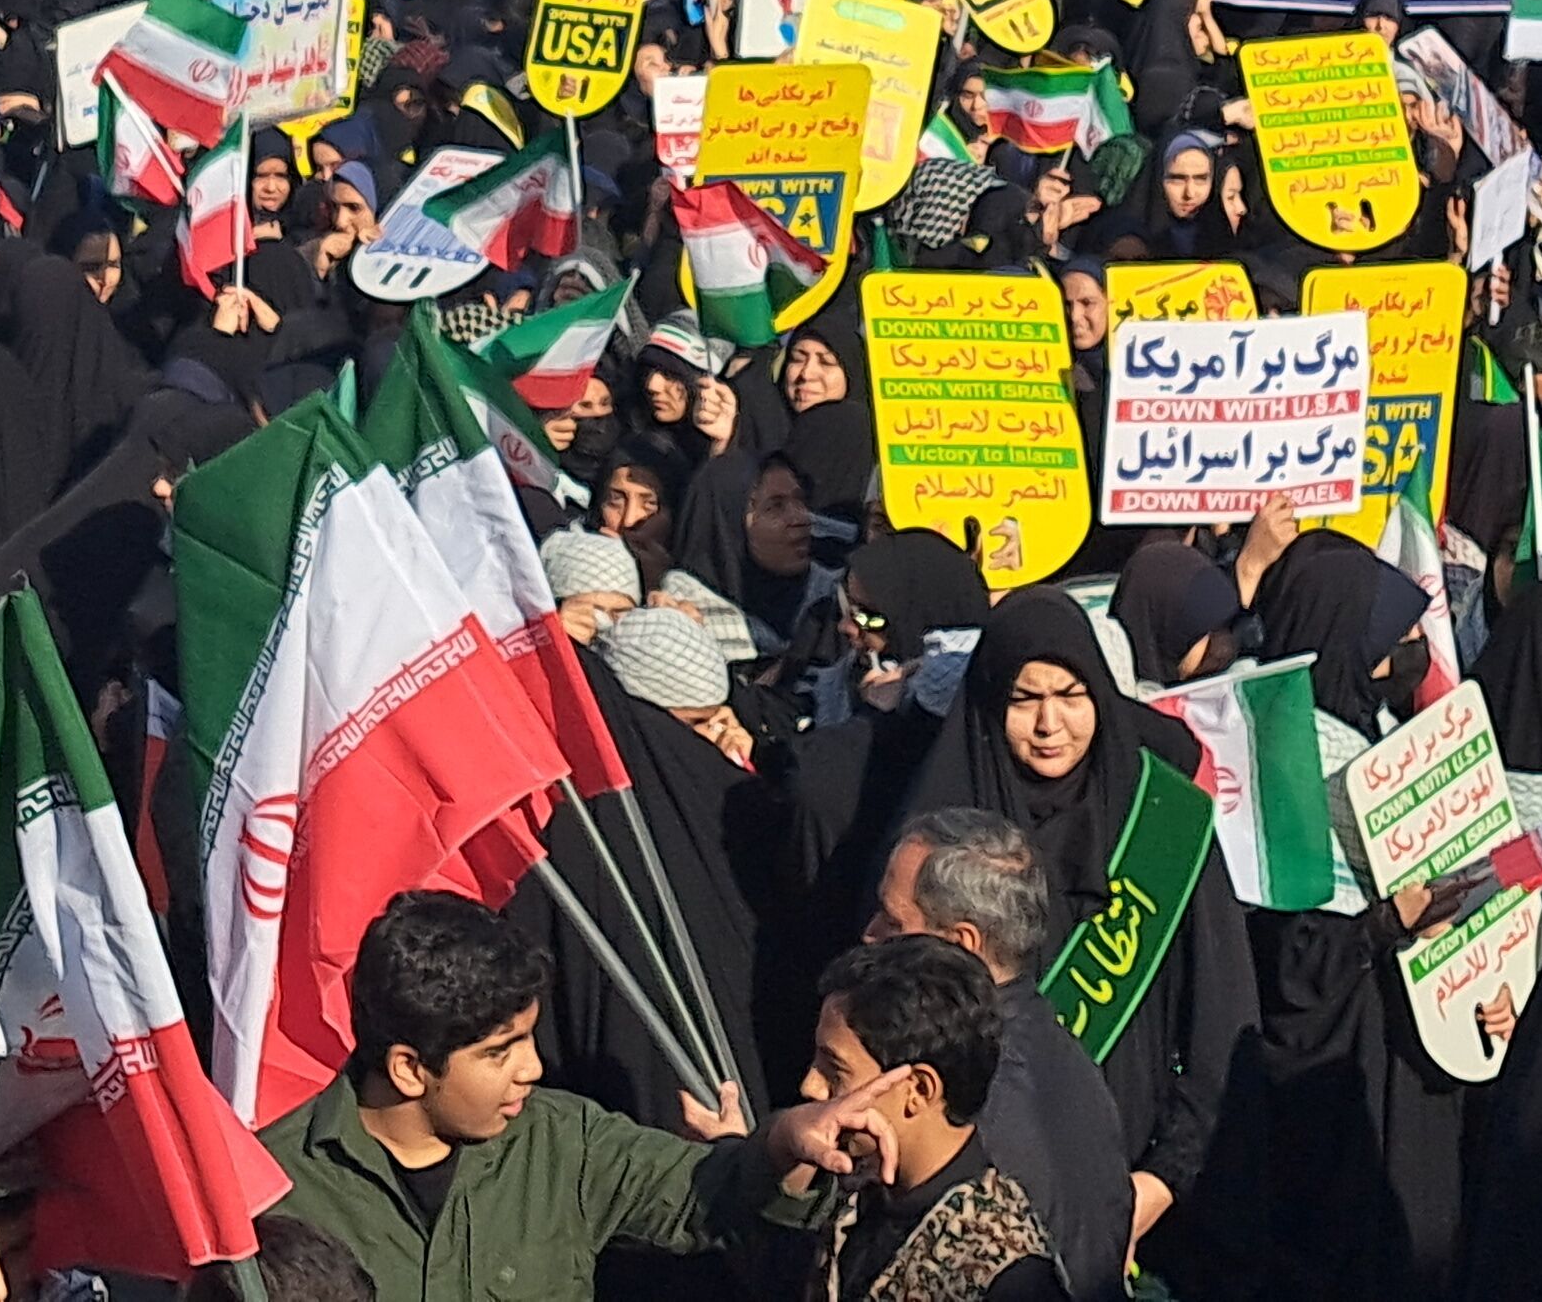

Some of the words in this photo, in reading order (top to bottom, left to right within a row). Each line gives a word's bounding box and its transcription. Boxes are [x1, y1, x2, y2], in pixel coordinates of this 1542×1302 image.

[547, 7, 590, 24] DOWN
[591, 12, 628, 28] WITH
[542, 20, 617, 68] USA
[1317, 50, 1332, 66] بر
[1337, 41, 1375, 64] مرگ
[1255, 71, 1300, 86] DOWN
[1304, 66, 1341, 81] WITH
[1332, 81, 1383, 105] الموت
[789, 122, 798, 138] و
[1262, 112, 1306, 127] DOWN
[1308, 108, 1343, 124] WITH
[1345, 104, 1395, 120] ISRAEL
[1346, 123, 1397, 146] الموت
[773, 146, 808, 164] شده
[1279, 154, 1334, 169] Victory
[1337, 151, 1354, 163] to
[1354, 148, 1399, 162] Islam
[735, 179, 777, 197] WN
[779, 178, 835, 195] WITH
[881, 284, 956, 315] امریکا
[963, 296, 985, 318] بر
[991, 286, 1039, 318] مرگ
[878, 320, 941, 337] DOWN
[945, 322, 998, 339] WITH
[890, 343, 978, 376] لامریکا
[983, 347, 1051, 378] الموت
[1124, 329, 1256, 395] آمریکا
[1249, 347, 1287, 395] بر
[1293, 329, 1360, 389] مرگ
[884, 381, 943, 398] DOWN
[947, 382, 996, 399] WITH
[1000, 383, 1067, 400] ISRAEL
[1130, 400, 1210, 421] DOWN
[1221, 397, 1287, 420] WITH
[1292, 392, 1350, 417] U.S.A
[893, 407, 990, 439] لاسرائیل
[997, 409, 1065, 441] الموت
[1385, 400, 1432, 422] WITH
[904, 444, 979, 465] Victory
[983, 446, 1004, 463] to
[1009, 446, 1064, 464] Islam
[1116, 426, 1253, 484] اسرائیل
[1255, 441, 1289, 484] بر
[1297, 424, 1357, 476] مرگ
[1363, 422, 1421, 486] SA
[912, 473, 994, 512] للاسلام
[1121, 491, 1201, 512] DOWN
[1208, 490, 1267, 511] WITH
[1280, 483, 1341, 506] RAEL
[1439, 701, 1473, 740] مرگ
[1363, 735, 1419, 791] امریکا
[1423, 732, 1441, 764] بر
[1368, 788, 1415, 834] DOWN
[1413, 762, 1452, 799] WITH
[1450, 763, 1494, 815] الموت
[1385, 796, 1448, 862] لامریکا
[1430, 837, 1466, 874] WITH
[1465, 804, 1509, 849] ISRAEL
[1056, 876, 1158, 1039] انتظاما
[1418, 925, 1469, 971] Victory
